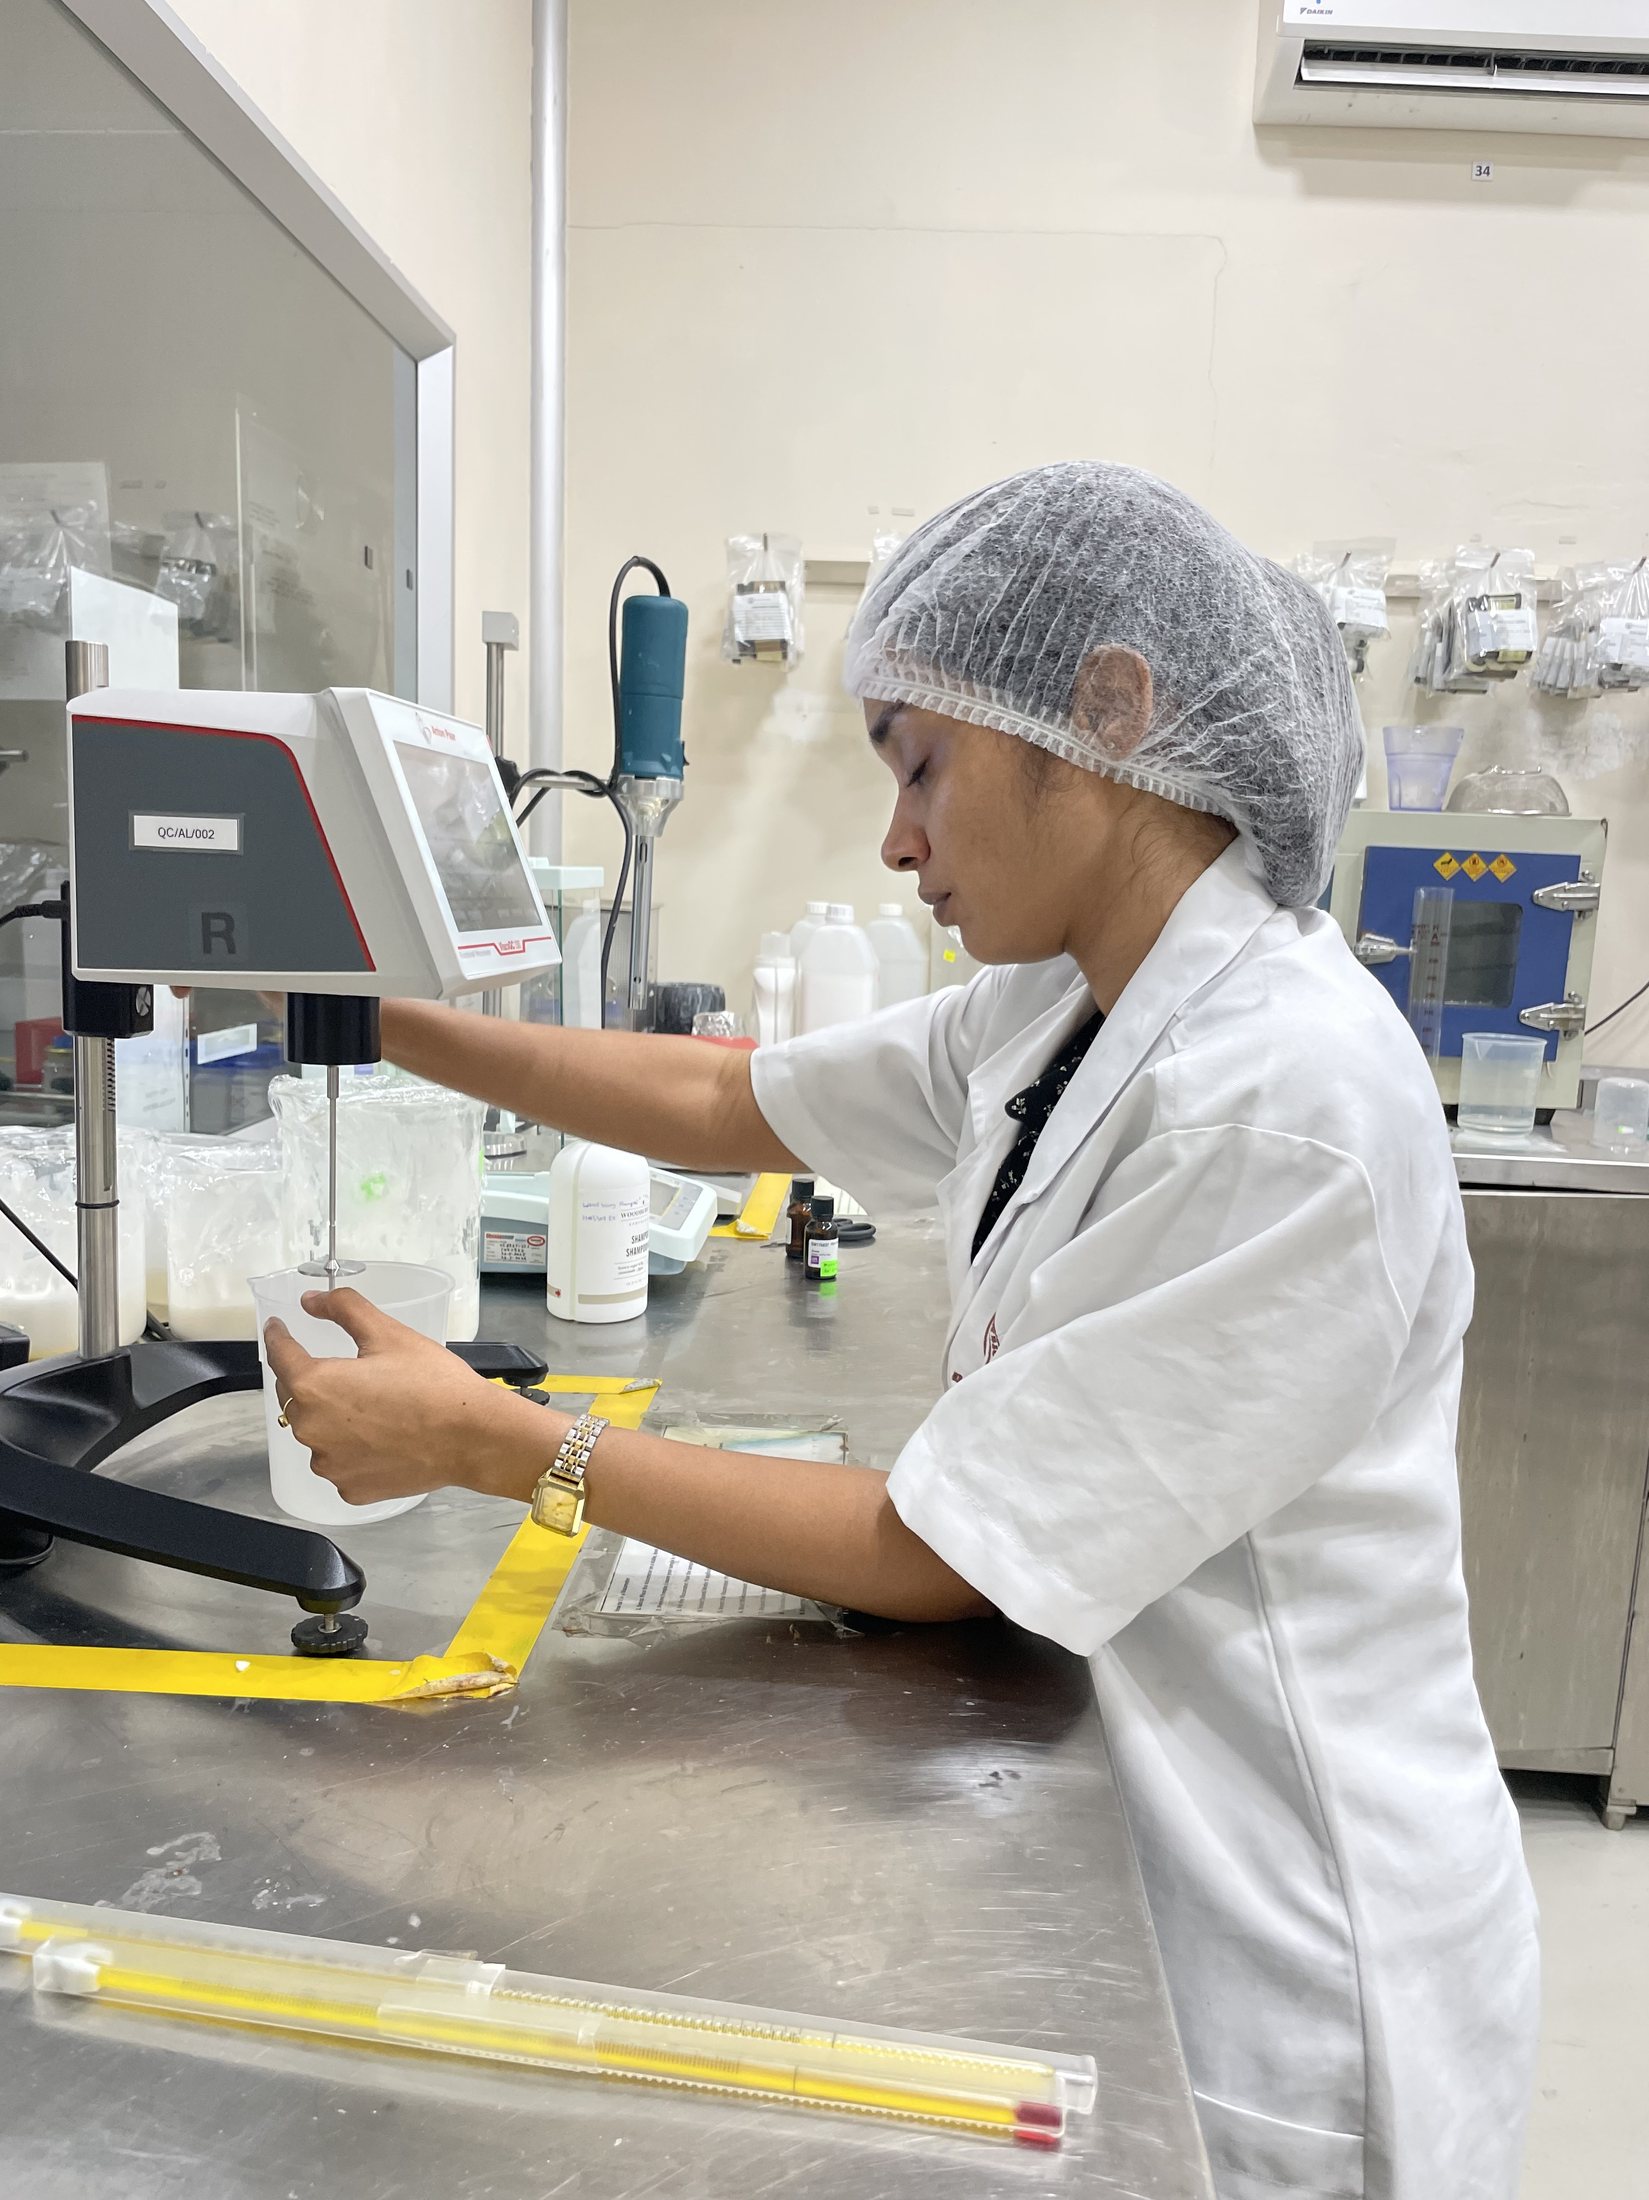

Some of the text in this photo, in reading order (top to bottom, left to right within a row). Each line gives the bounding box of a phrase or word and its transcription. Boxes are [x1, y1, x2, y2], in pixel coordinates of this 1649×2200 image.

[1474, 165, 1490, 177] 34
[157, 827, 215, 840] QC/AL/002
[201, 911, 237, 954] R
